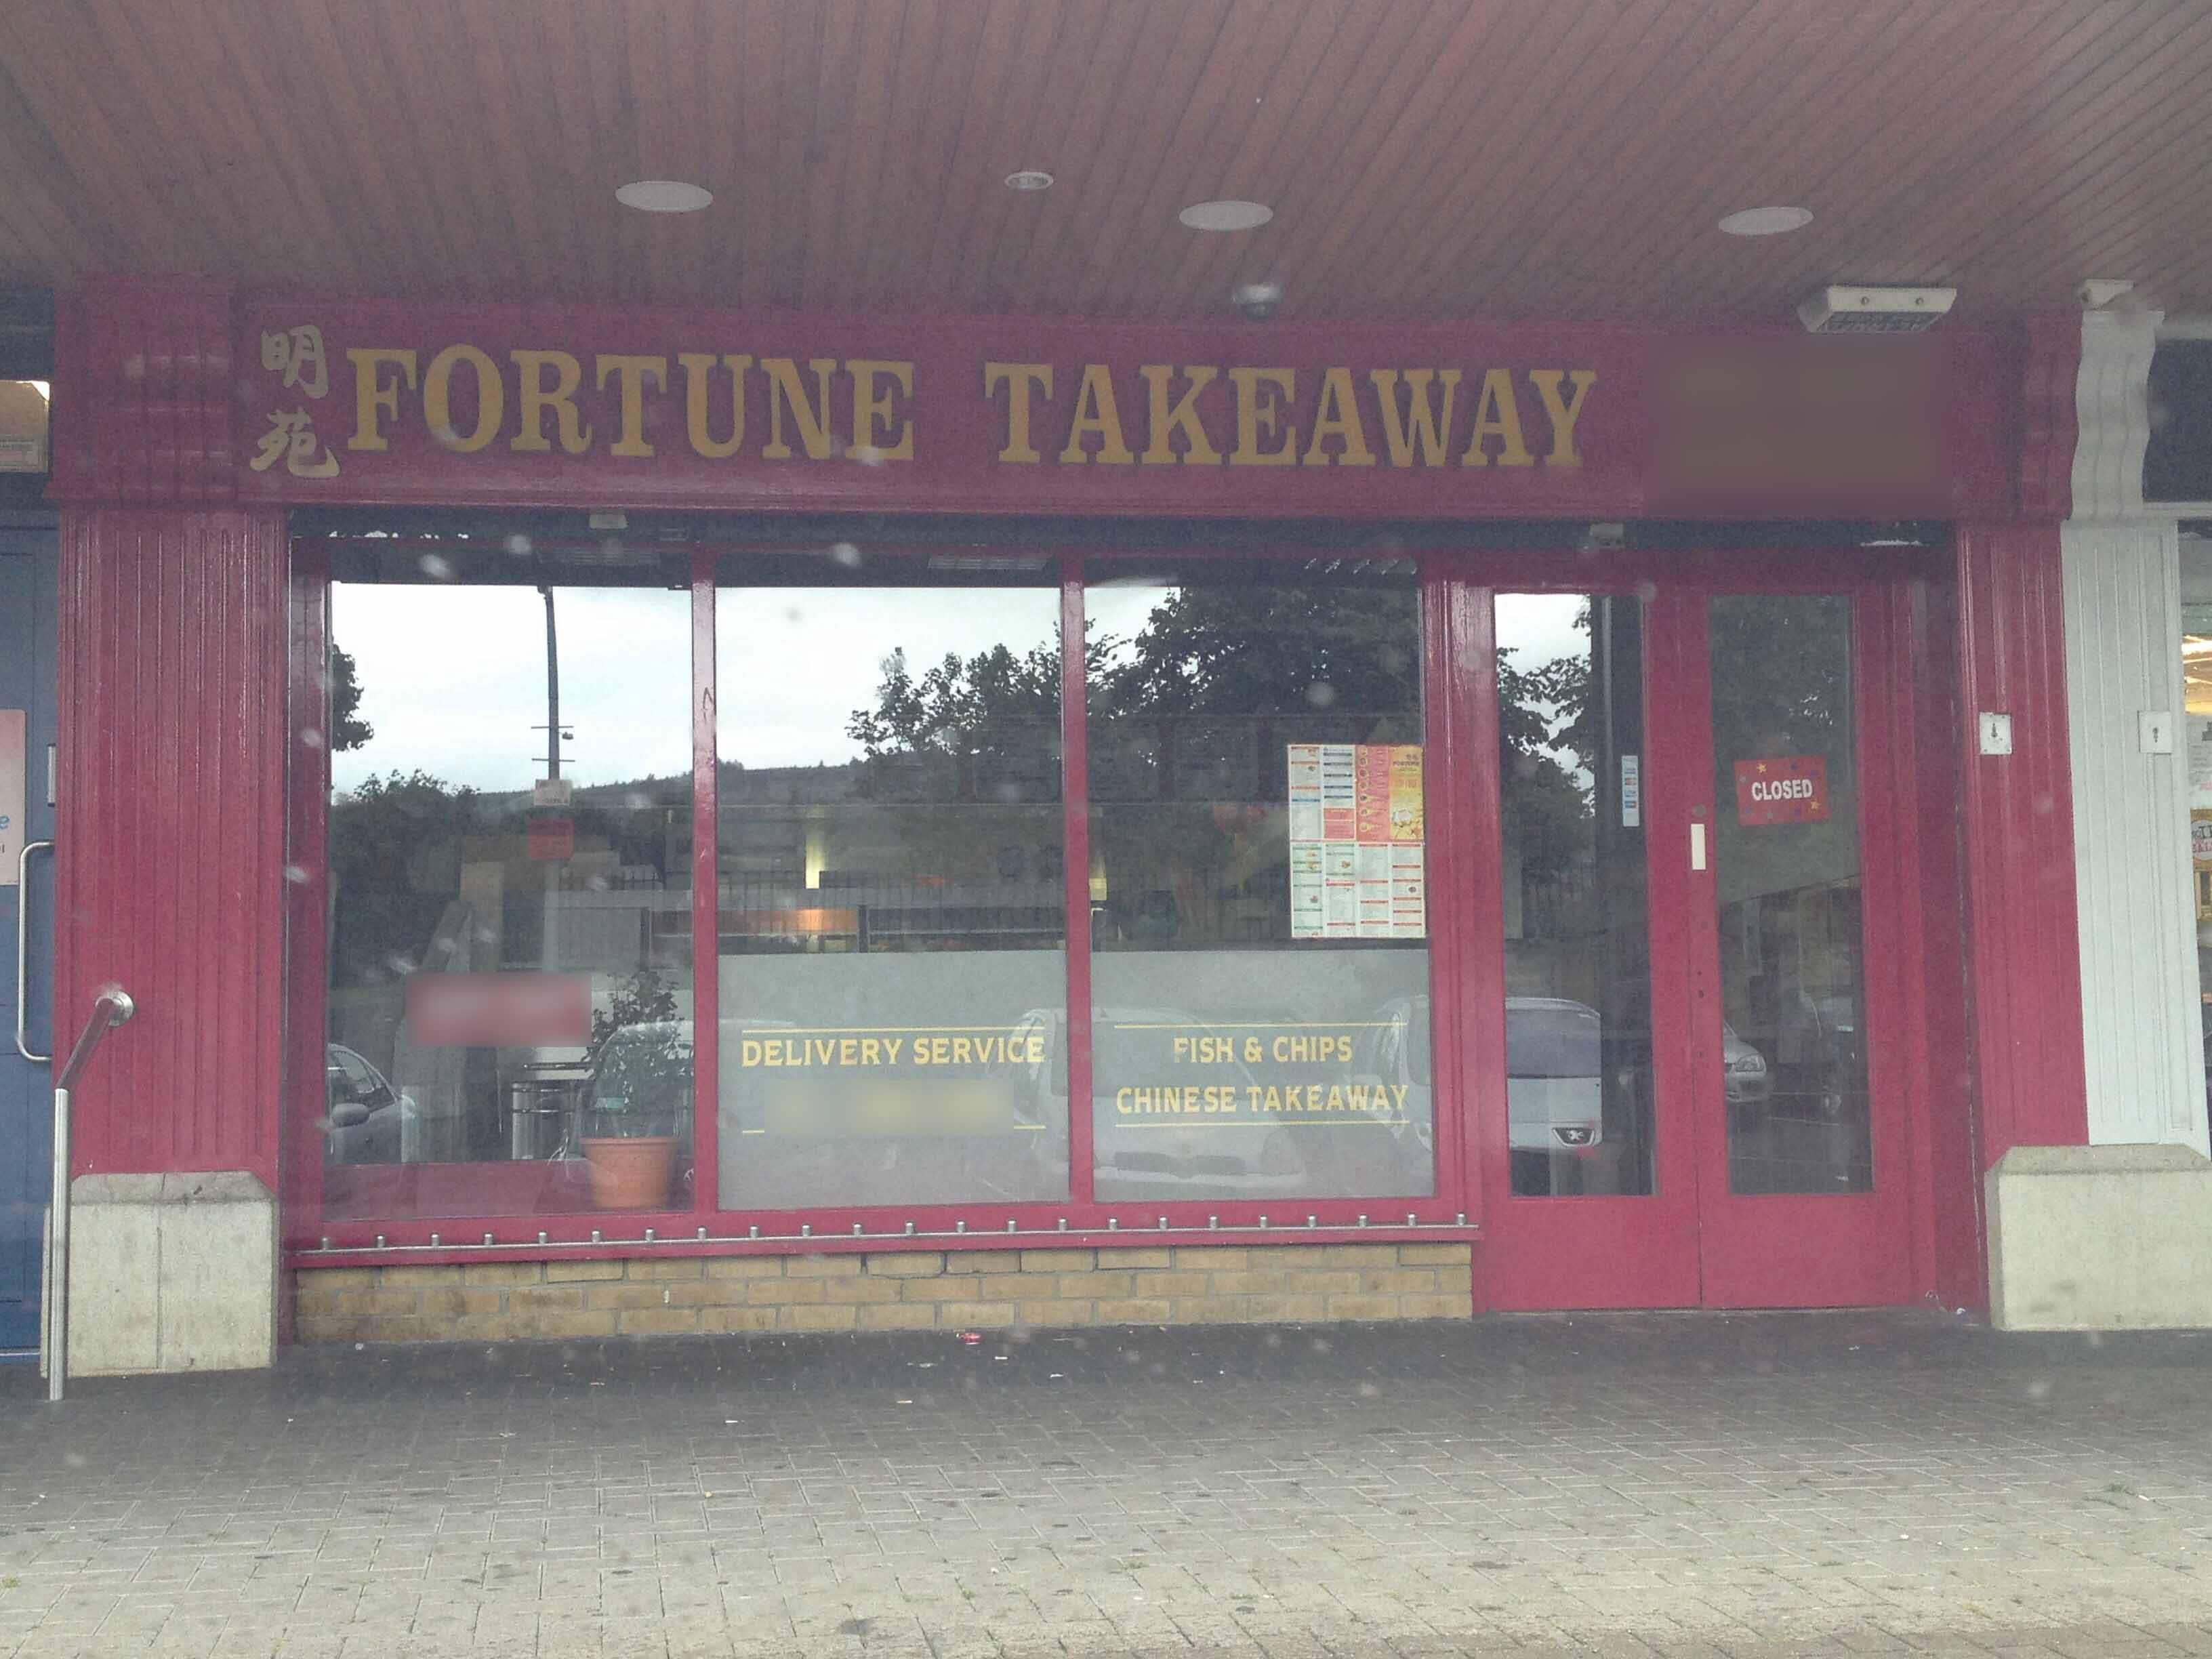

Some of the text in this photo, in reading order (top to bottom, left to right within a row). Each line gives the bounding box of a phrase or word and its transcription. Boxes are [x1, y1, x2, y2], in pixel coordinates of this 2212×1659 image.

[250, 325, 340, 478] 明苑
[346, 343, 1598, 468] FORTUNE TAKEAWAY
[1752, 779, 1813, 801] CLOSED
[741, 1036, 1046, 1067] DELIVERY SERVICE
[1173, 1035, 1354, 1063] FISH & CHIPS
[1117, 1084, 1409, 1113] CHINESE TAKEAWAY
